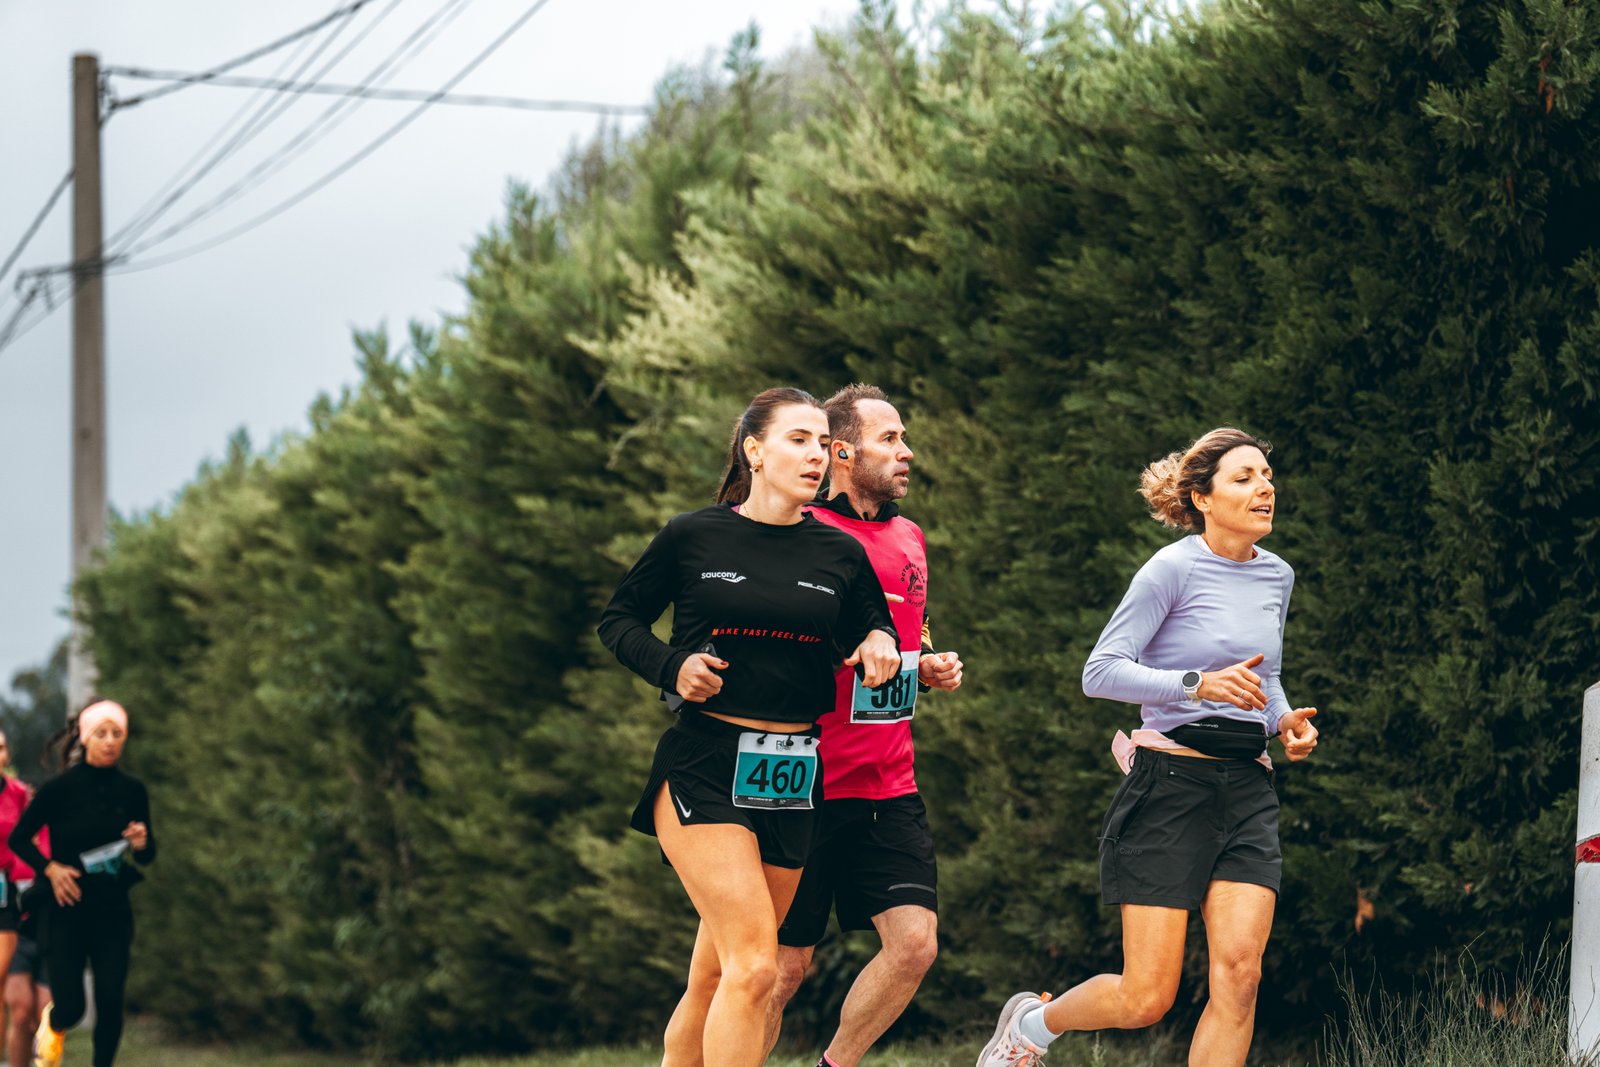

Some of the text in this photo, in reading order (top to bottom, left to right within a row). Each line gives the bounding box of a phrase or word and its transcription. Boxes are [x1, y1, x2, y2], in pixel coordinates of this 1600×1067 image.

[701, 571, 737, 579] saucony
[712, 628, 739, 636] MAKE
[743, 628, 768, 637] FAST
[771, 631, 794, 640] FEEL
[746, 758, 807, 794] 460
